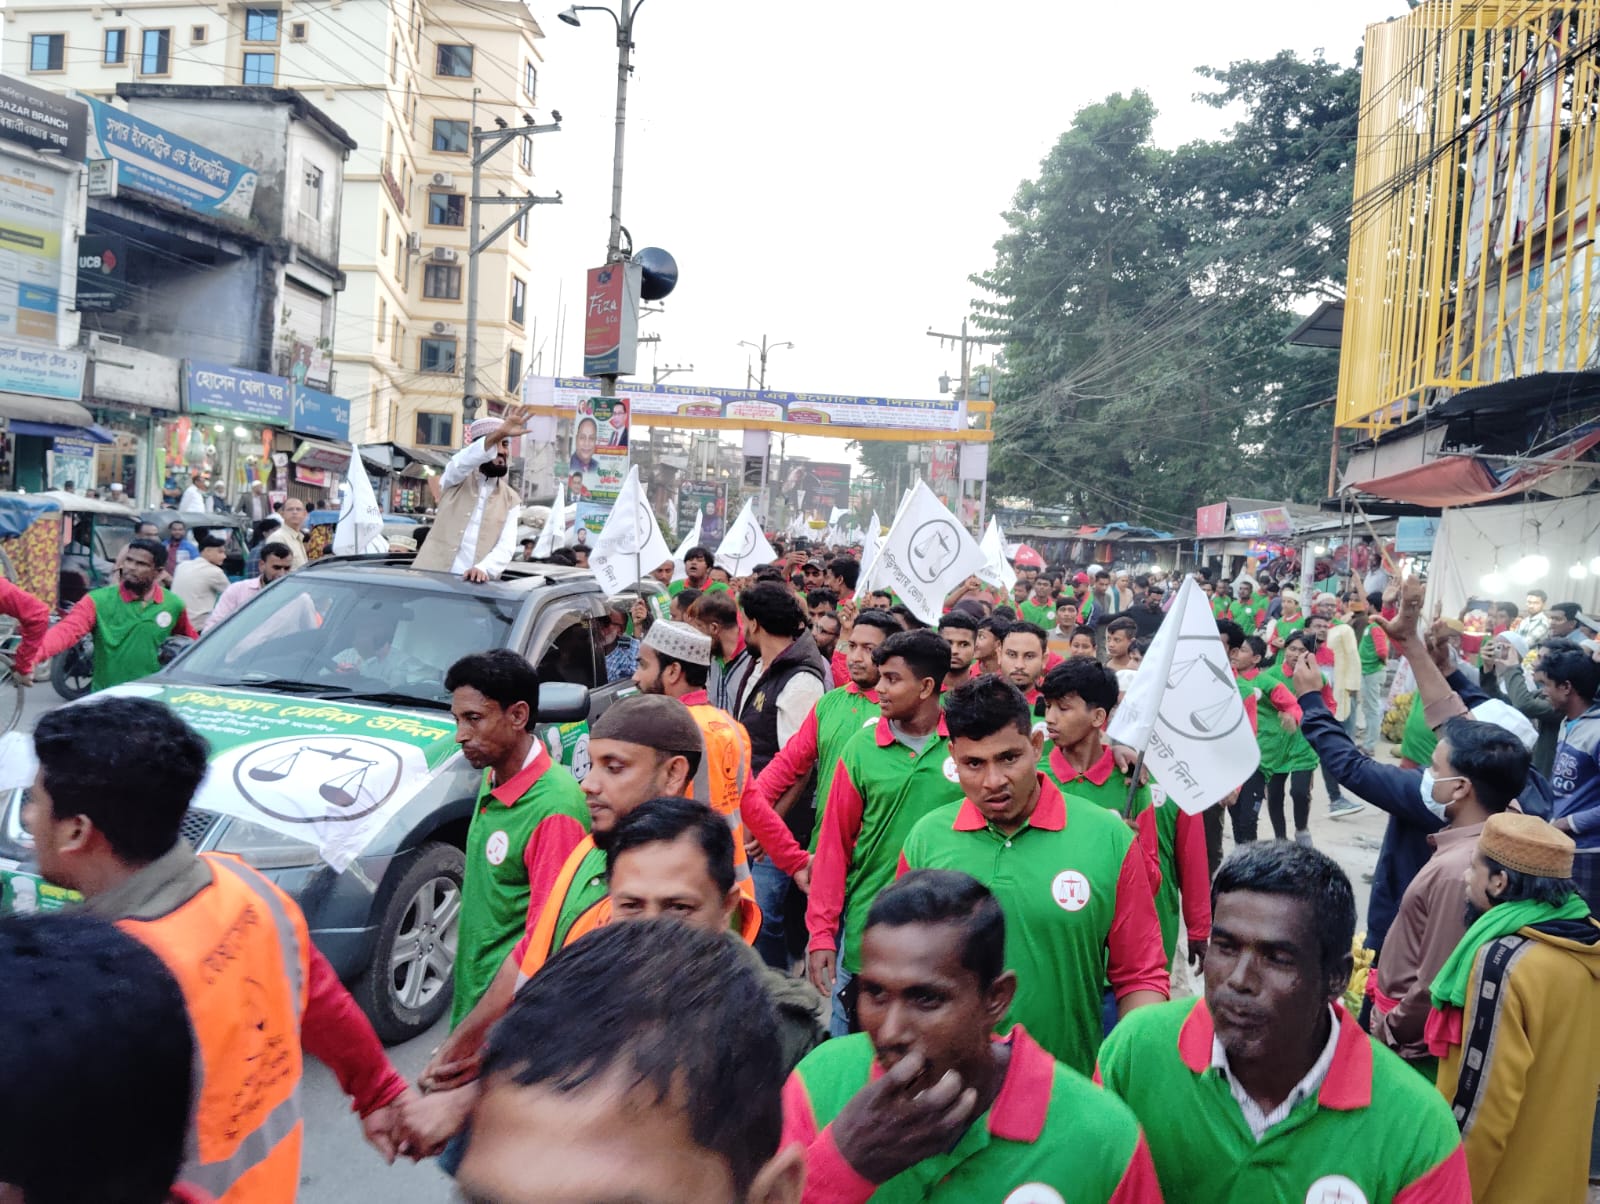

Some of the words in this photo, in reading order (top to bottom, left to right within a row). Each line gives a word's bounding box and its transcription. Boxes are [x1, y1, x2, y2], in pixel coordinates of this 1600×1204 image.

[31, 110, 69, 130] BRANCH
[106, 117, 131, 142] সুপার
[79, 256, 101, 269] UCB
[588, 292, 618, 318] Fiza
[196, 370, 235, 393] হোসেন
[239, 378, 265, 399] খেলা
[267, 382, 284, 401] ঘর
[365, 715, 451, 742] উদ্দিন
